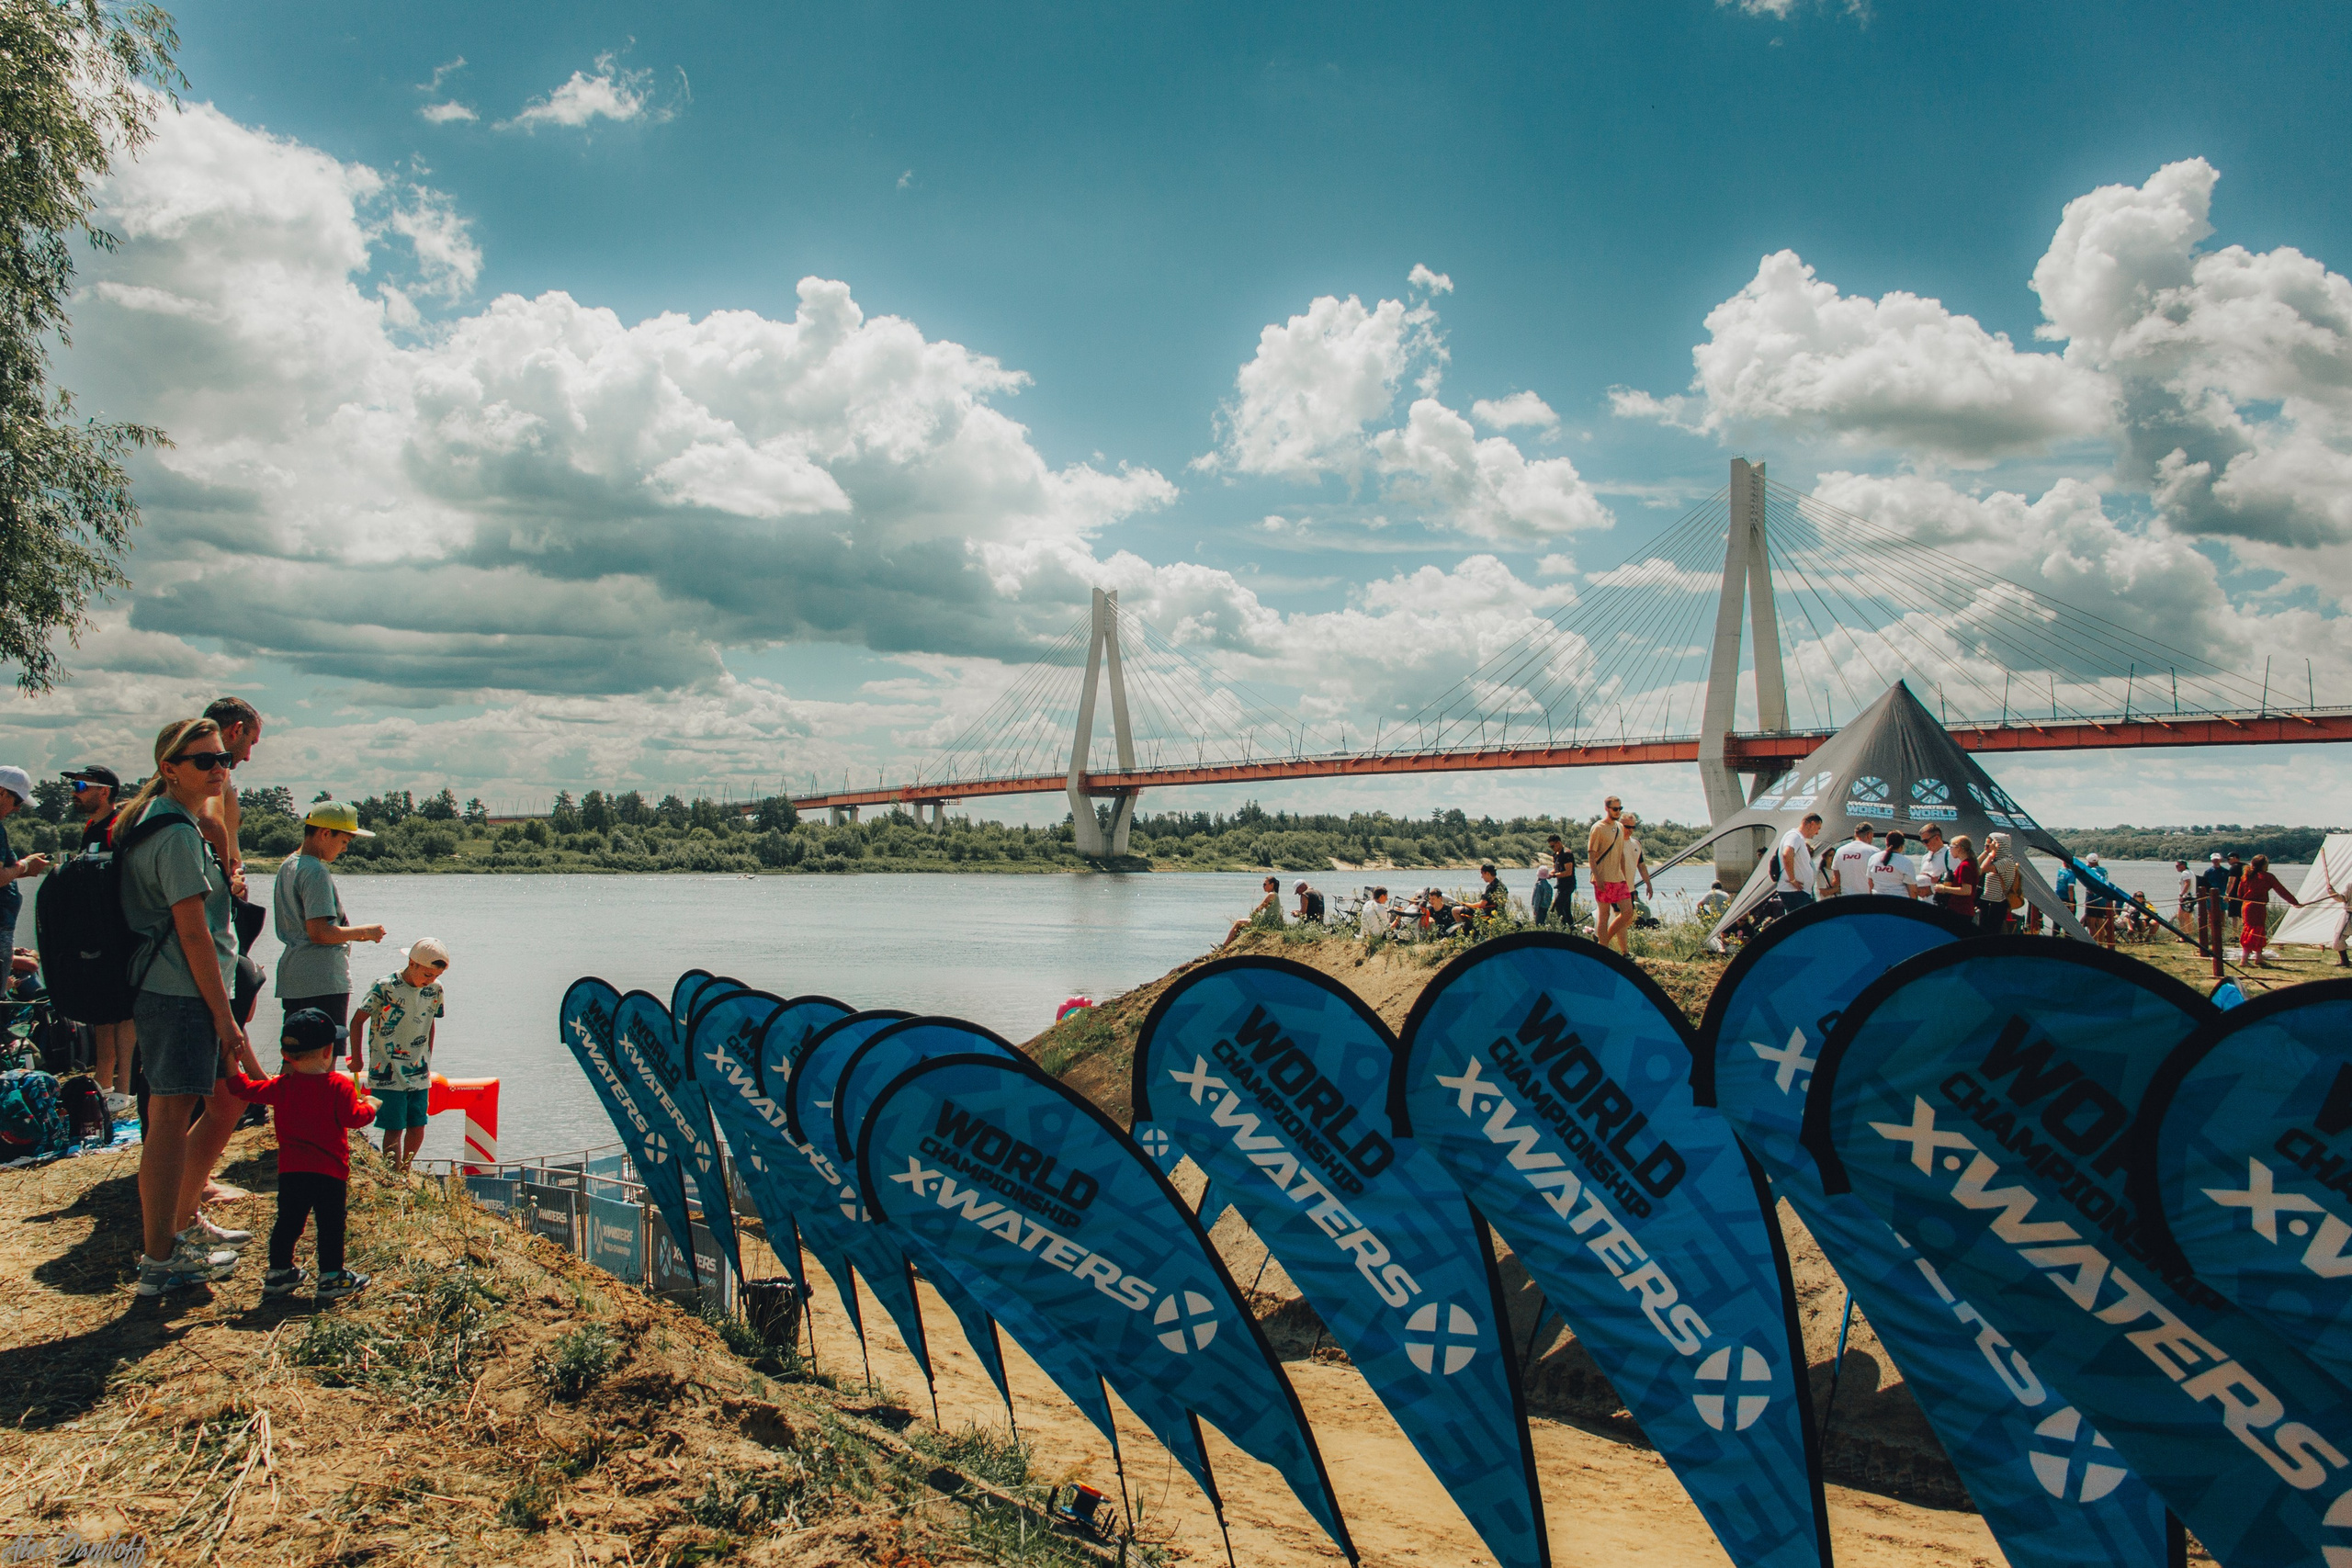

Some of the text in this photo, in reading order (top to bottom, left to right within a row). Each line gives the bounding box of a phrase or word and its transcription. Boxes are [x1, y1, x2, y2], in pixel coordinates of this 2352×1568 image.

[1846, 805, 1894, 816] WORLD
[632, 1010, 682, 1085] WORLD
[1235, 1003, 1395, 1179] WORLD
[1515, 991, 1687, 1199] WORLD
[919, 1136, 1081, 1228] CHAMPIONSHIP
[934, 1099, 1100, 1211] WORLD
[1212, 1039, 1364, 1194] CHAMPIONSHIP
[1487, 1036, 1652, 1219] CHAMPIONSHIP
